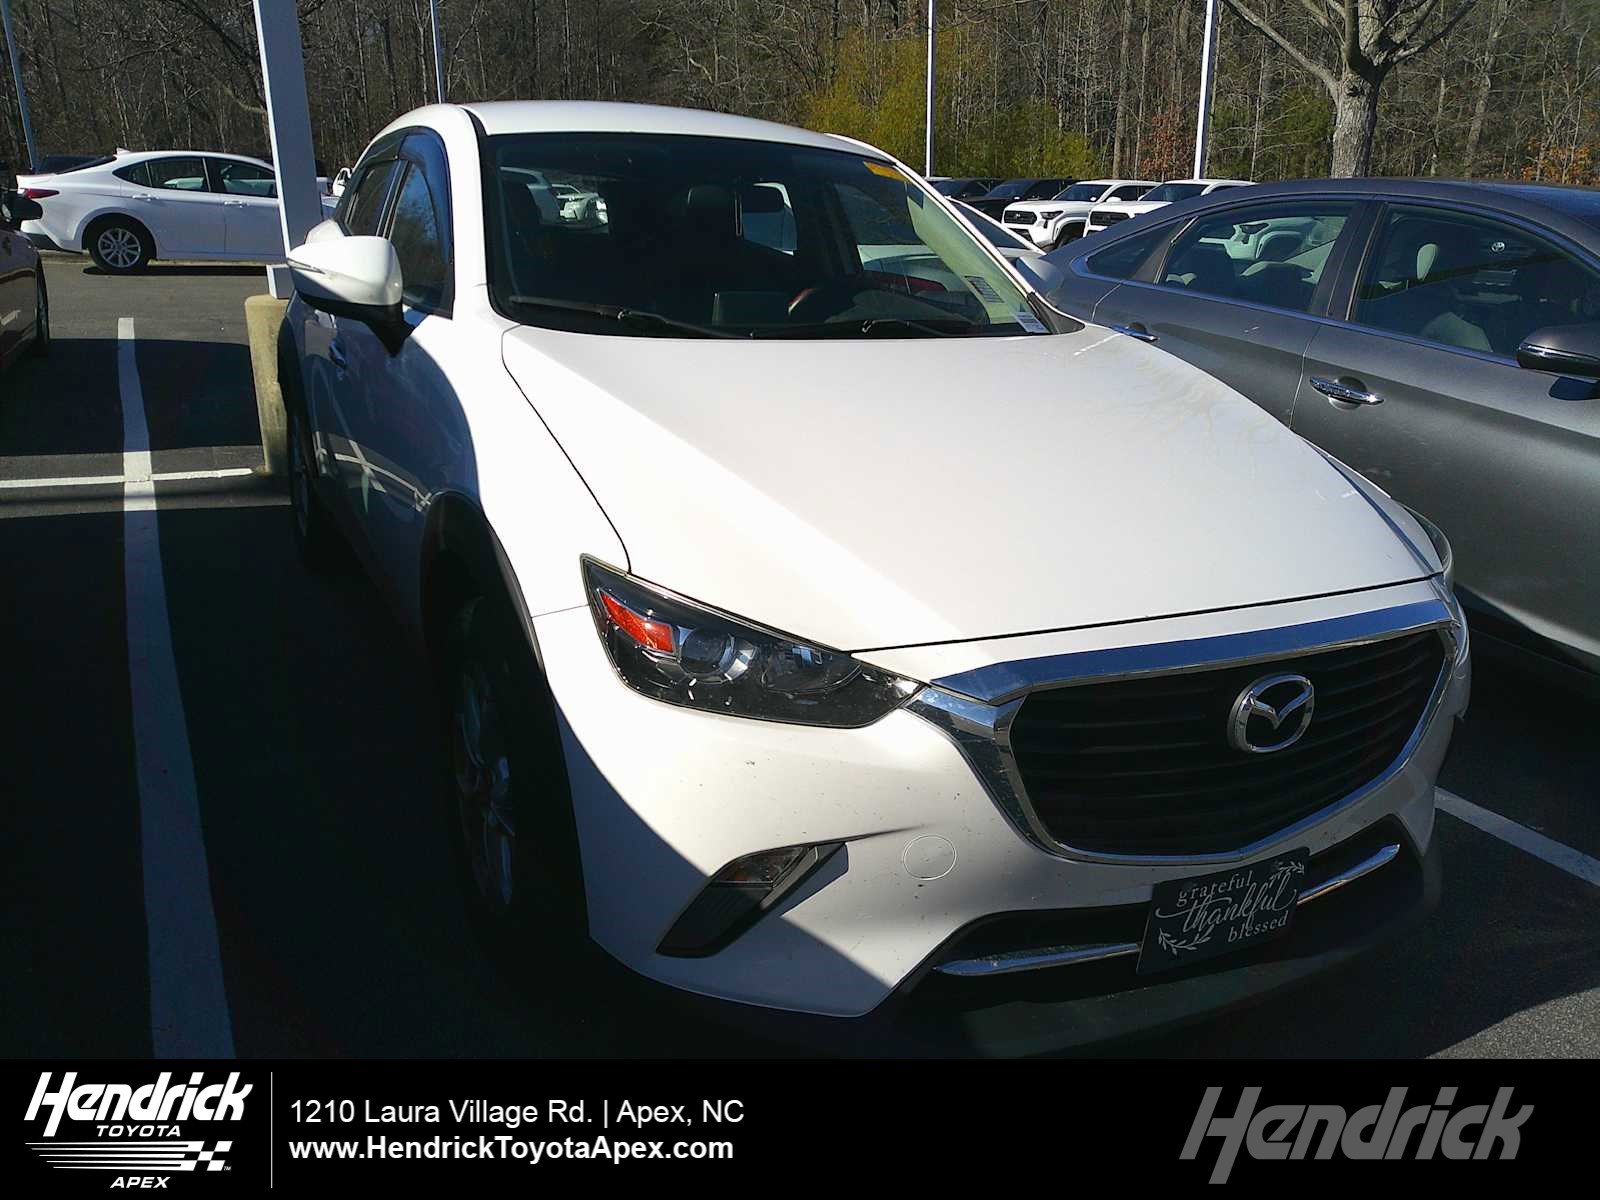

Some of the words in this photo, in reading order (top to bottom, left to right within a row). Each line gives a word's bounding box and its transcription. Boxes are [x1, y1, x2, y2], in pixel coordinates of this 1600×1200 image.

[1155, 872, 1297, 933] thankful
[1176, 870, 1253, 907] grateful
[1227, 910, 1289, 943] blessed
